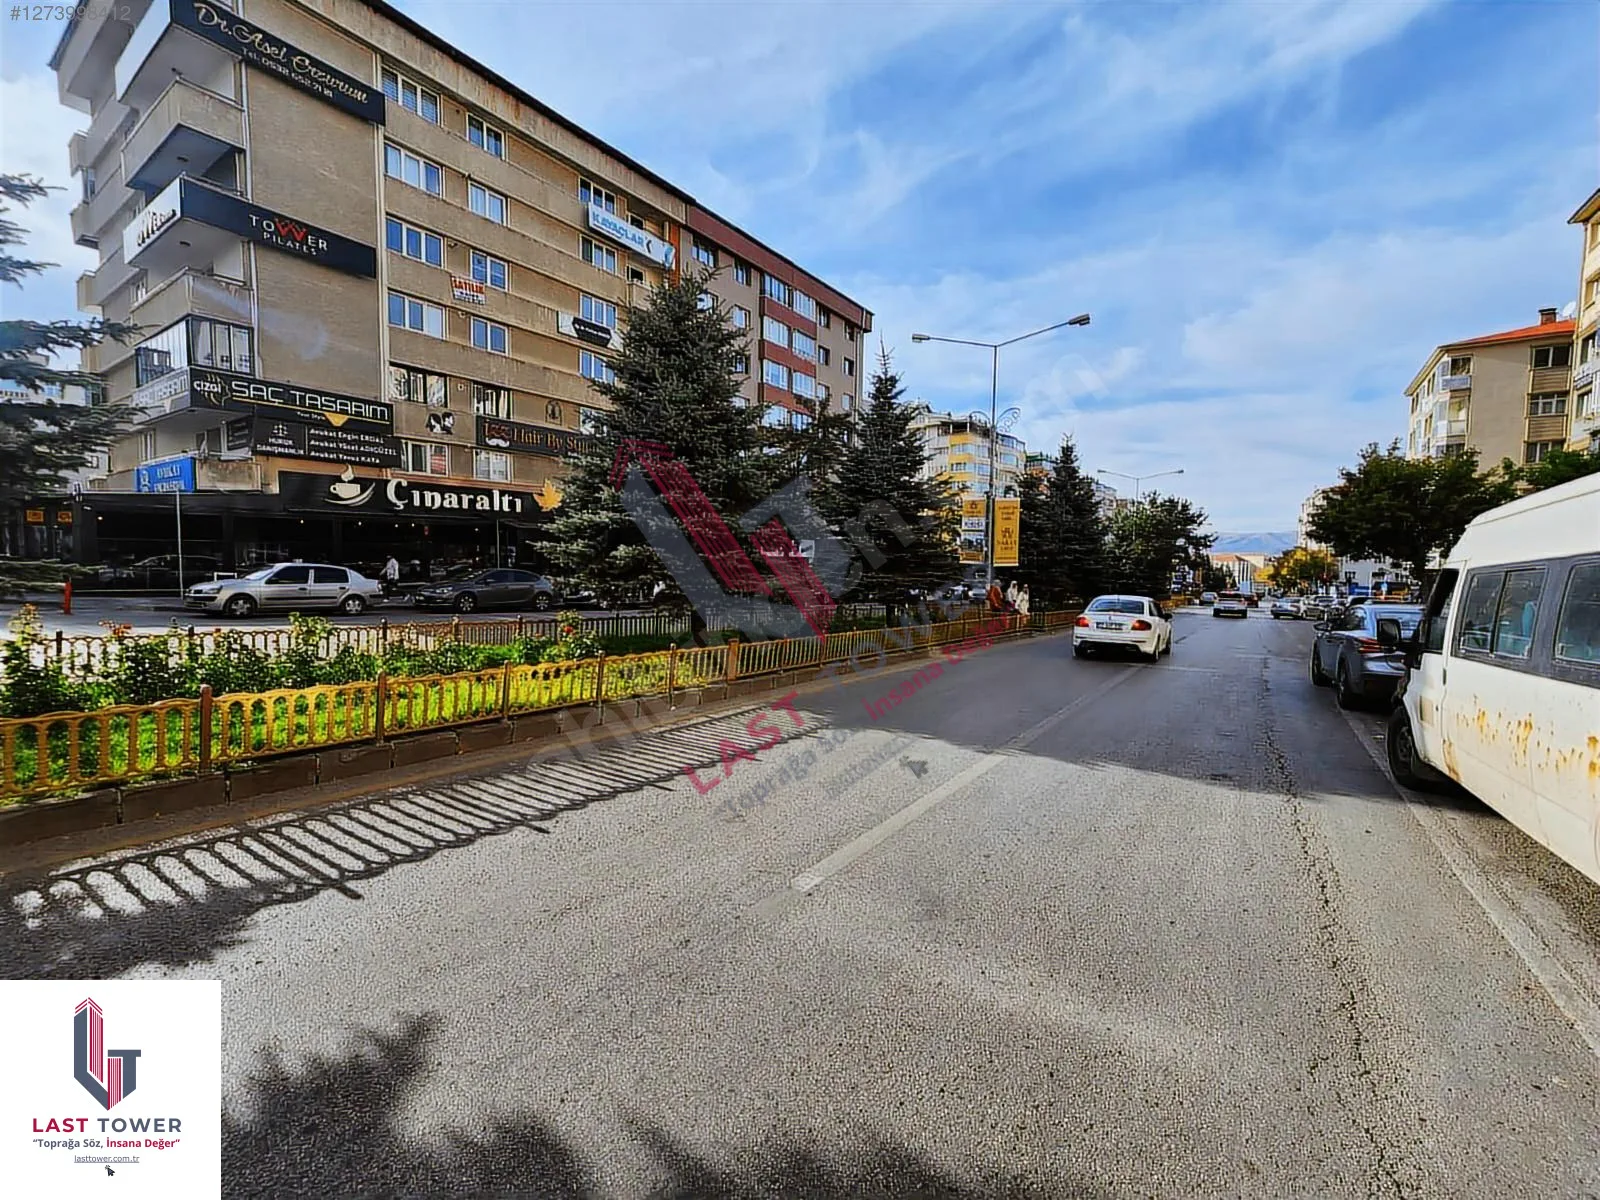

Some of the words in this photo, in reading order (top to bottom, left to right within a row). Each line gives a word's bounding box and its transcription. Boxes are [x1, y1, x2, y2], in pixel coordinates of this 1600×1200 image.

[249, 214, 328, 251] TOWER
[232, 381, 283, 405] SAÇ
[290, 390, 388, 420] TASARIM
[386, 478, 522, 513] Çınaraltı
